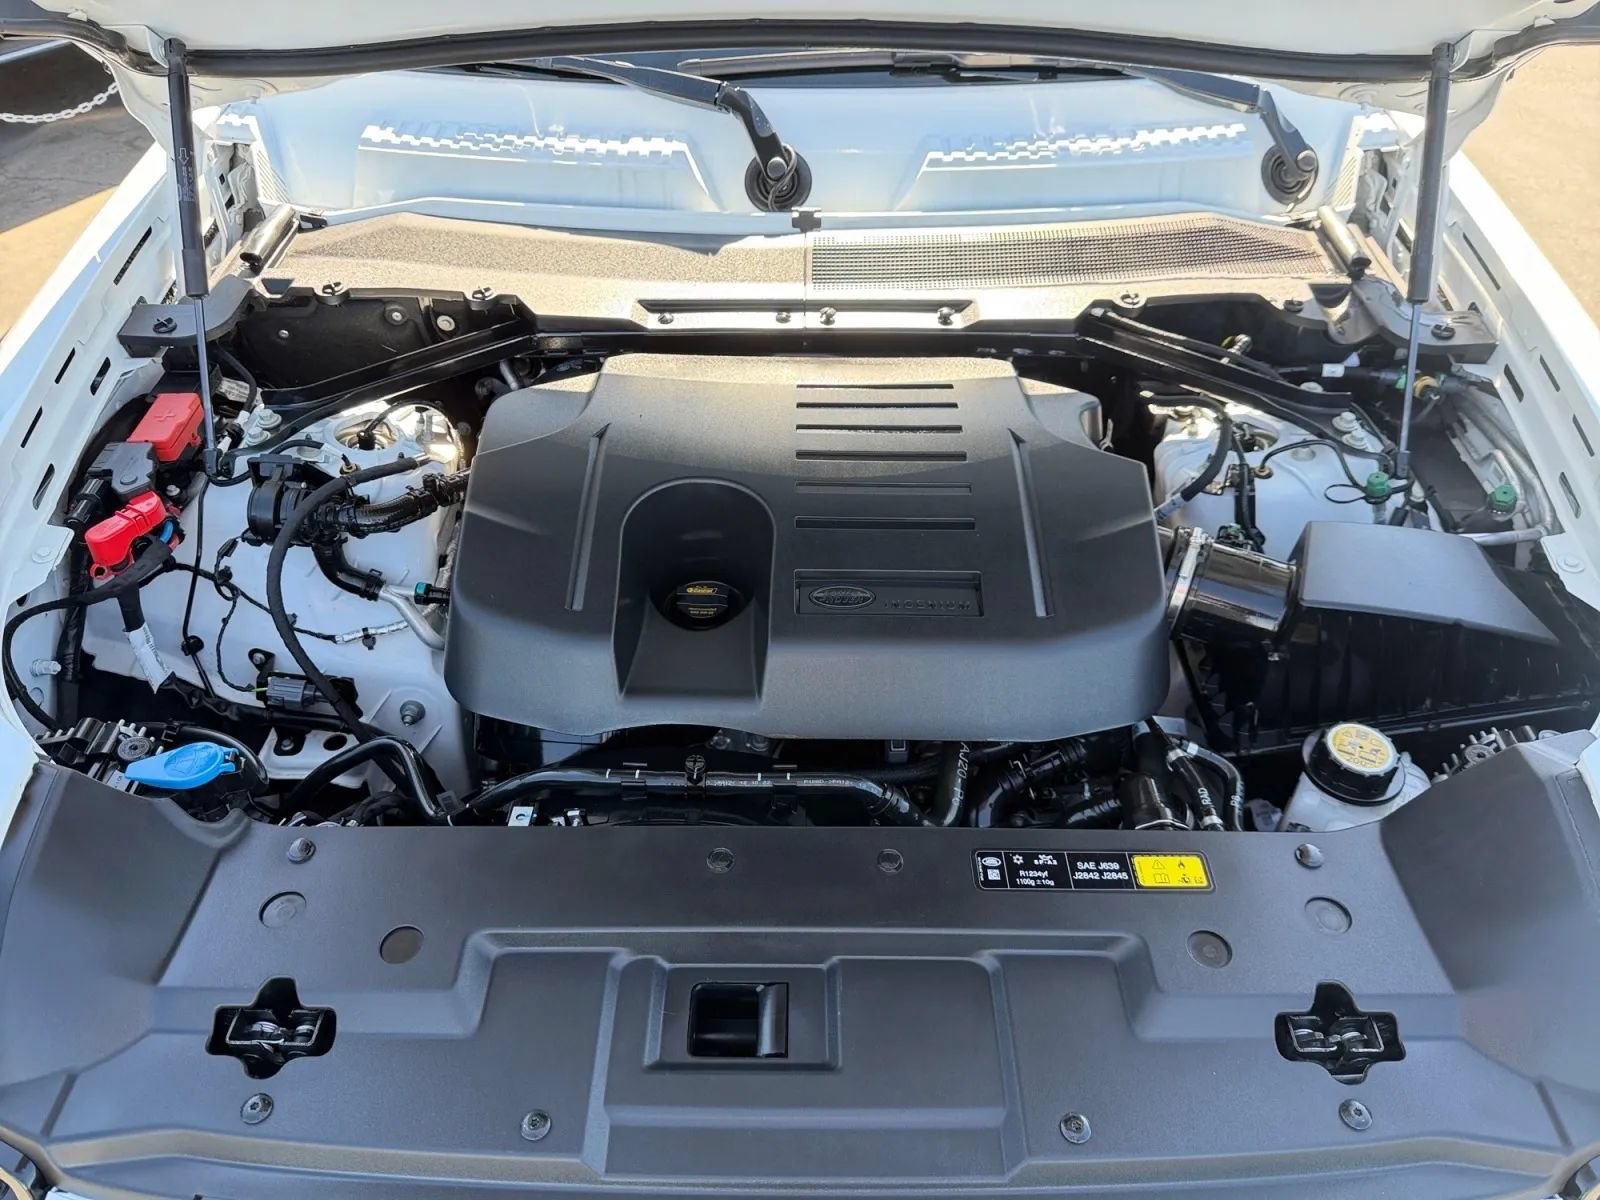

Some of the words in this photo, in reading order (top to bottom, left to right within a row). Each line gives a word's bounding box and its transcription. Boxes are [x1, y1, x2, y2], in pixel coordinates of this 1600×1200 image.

[1077, 862, 1096, 870] SAE
[1098, 862, 1120, 870] J639
[1019, 870, 1048, 878] R1234yf
[1073, 871, 1100, 880] J2842
[1101, 872, 1128, 880] J2845
